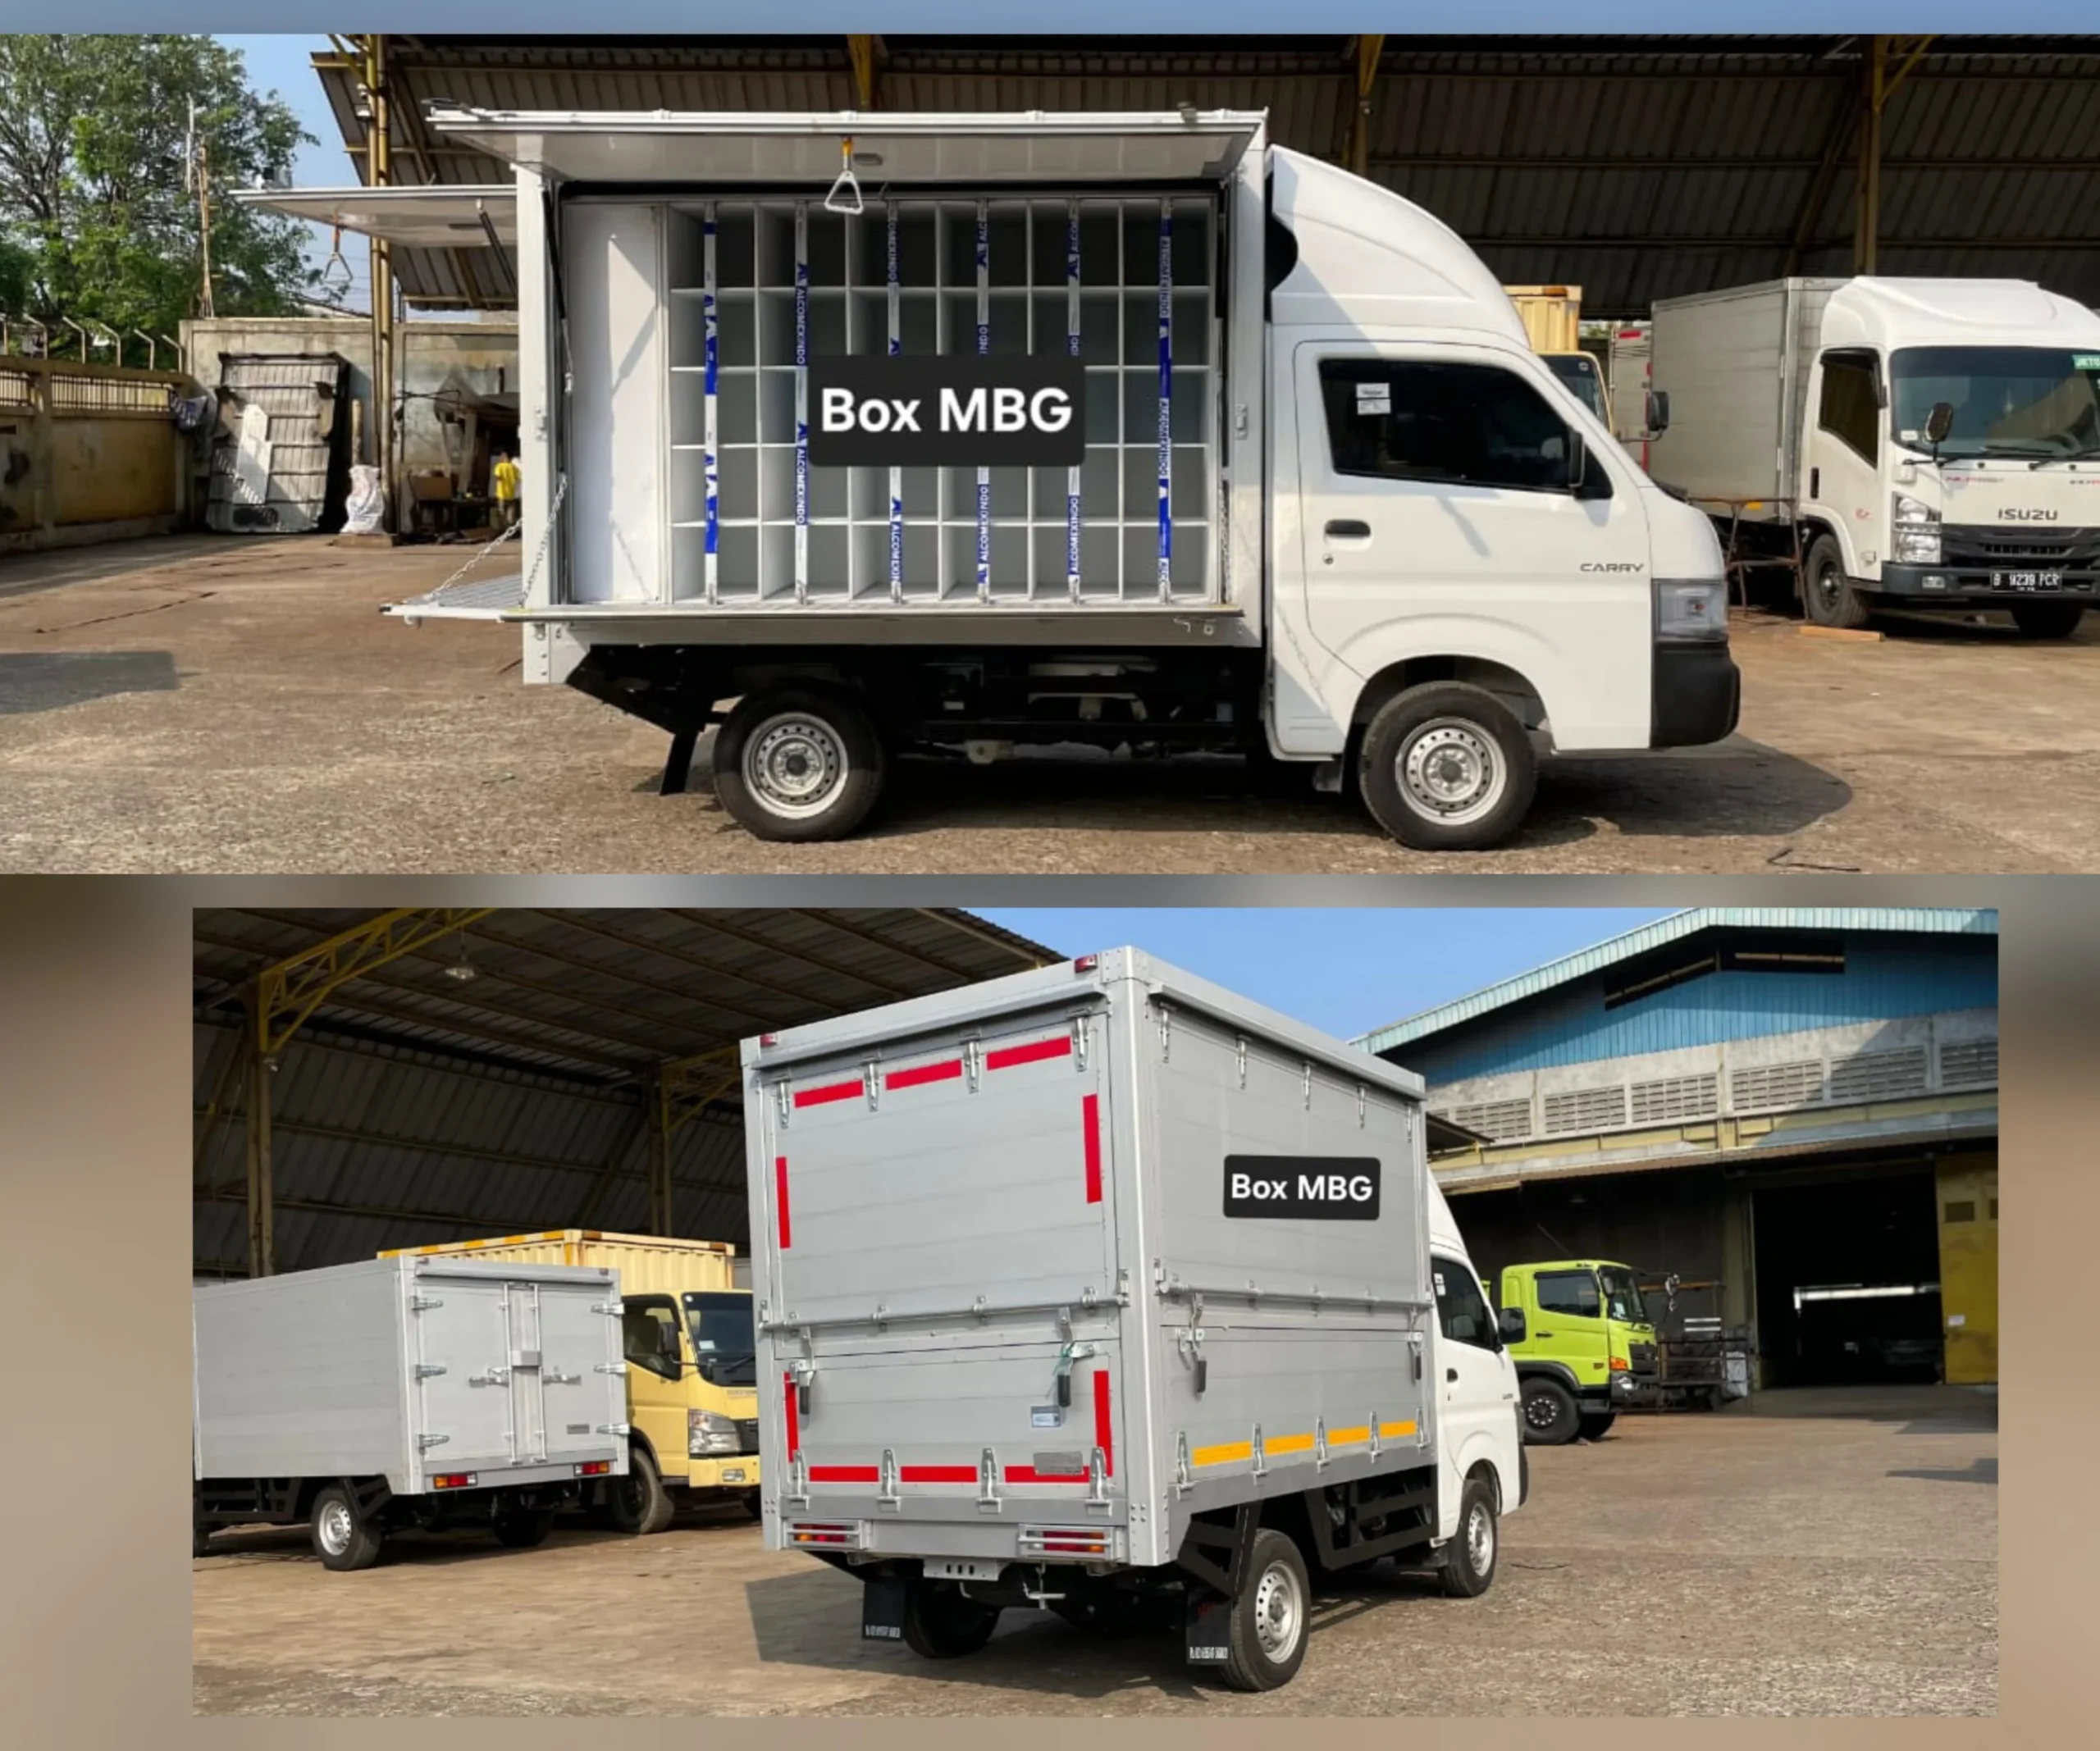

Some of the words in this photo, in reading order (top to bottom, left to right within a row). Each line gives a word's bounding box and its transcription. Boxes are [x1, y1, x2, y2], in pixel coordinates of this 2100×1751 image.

[796, 289, 806, 365] ALCOMEXINDO
[796, 448, 806, 525] ALCOMEXINDO
[979, 485, 989, 562] ALCOMEXINDO
[1997, 508, 2058, 521] ISUZU
[1070, 497, 1079, 573] ALCOMEXINDO
[1580, 563, 1645, 573] CARRY
